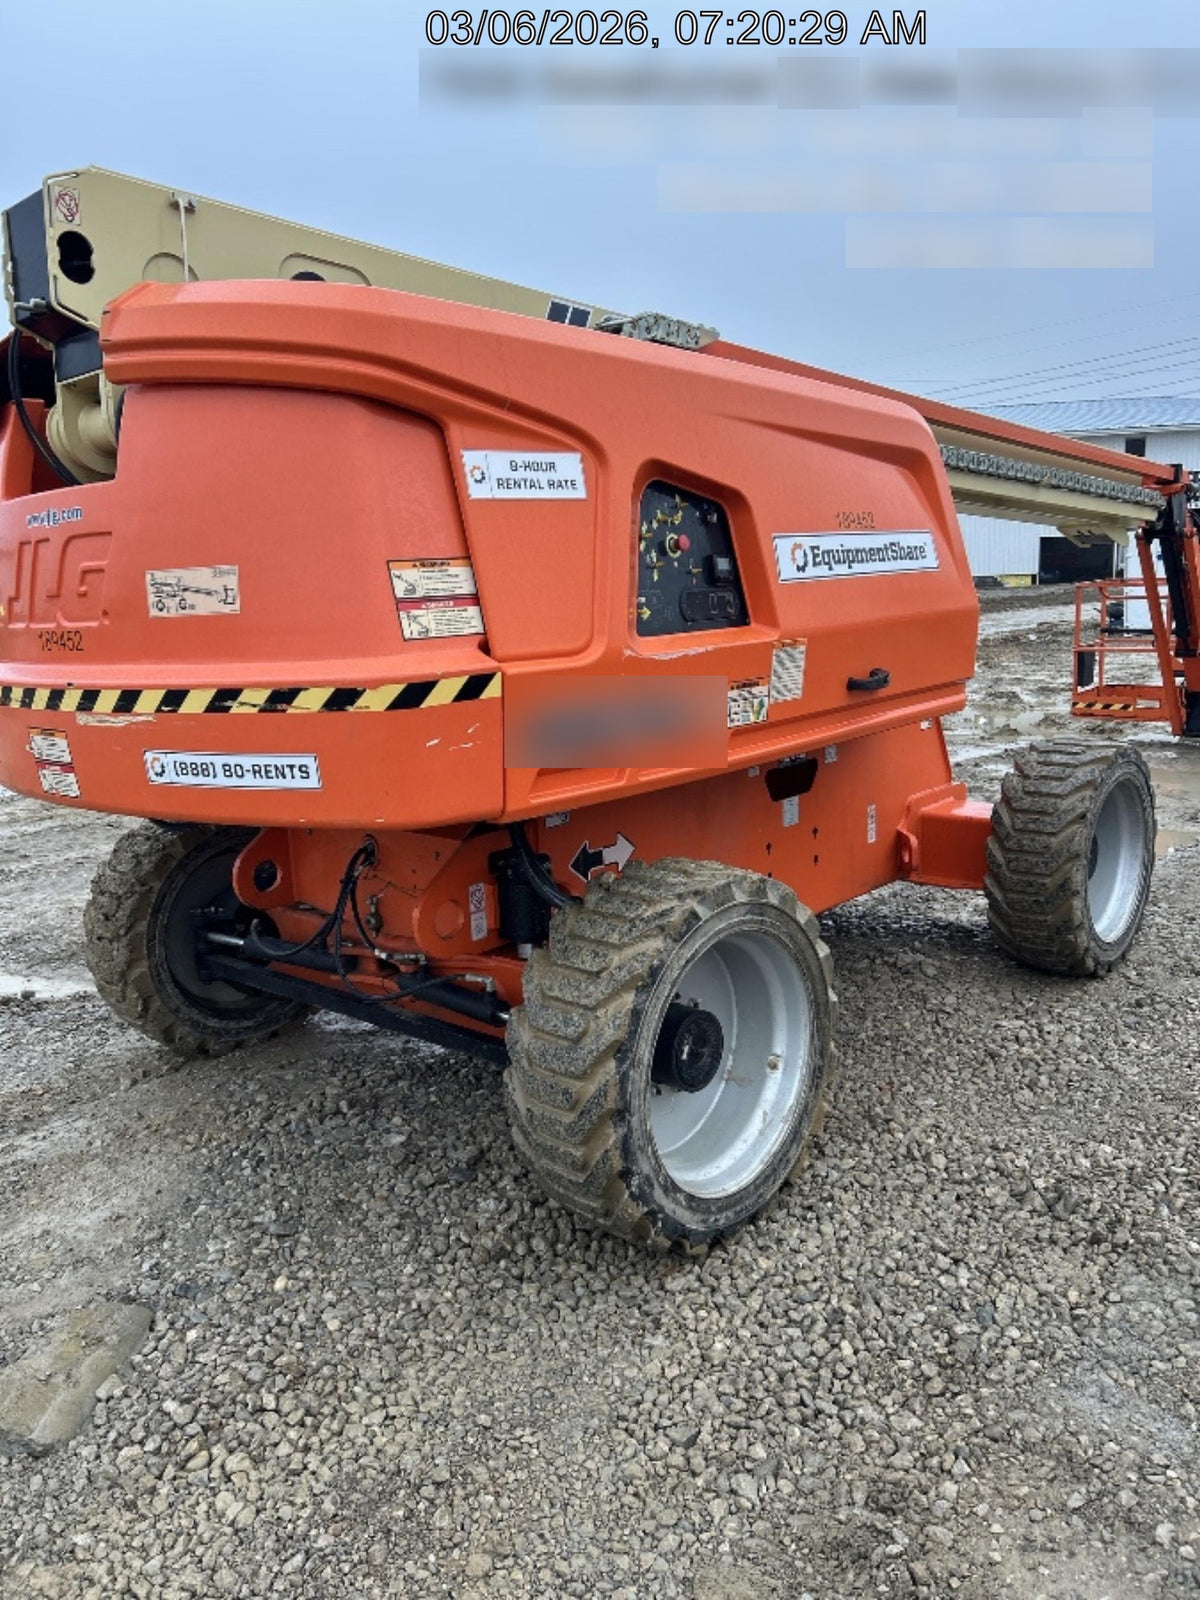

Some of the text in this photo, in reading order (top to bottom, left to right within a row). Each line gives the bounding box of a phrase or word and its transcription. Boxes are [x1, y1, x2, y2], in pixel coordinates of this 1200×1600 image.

[509, 459, 557, 473] 8-HOUR
[496, 477, 578, 491] RENTAL RATE
[811, 541, 928, 571] EquipmentShare
[173, 760, 217, 779] (888)
